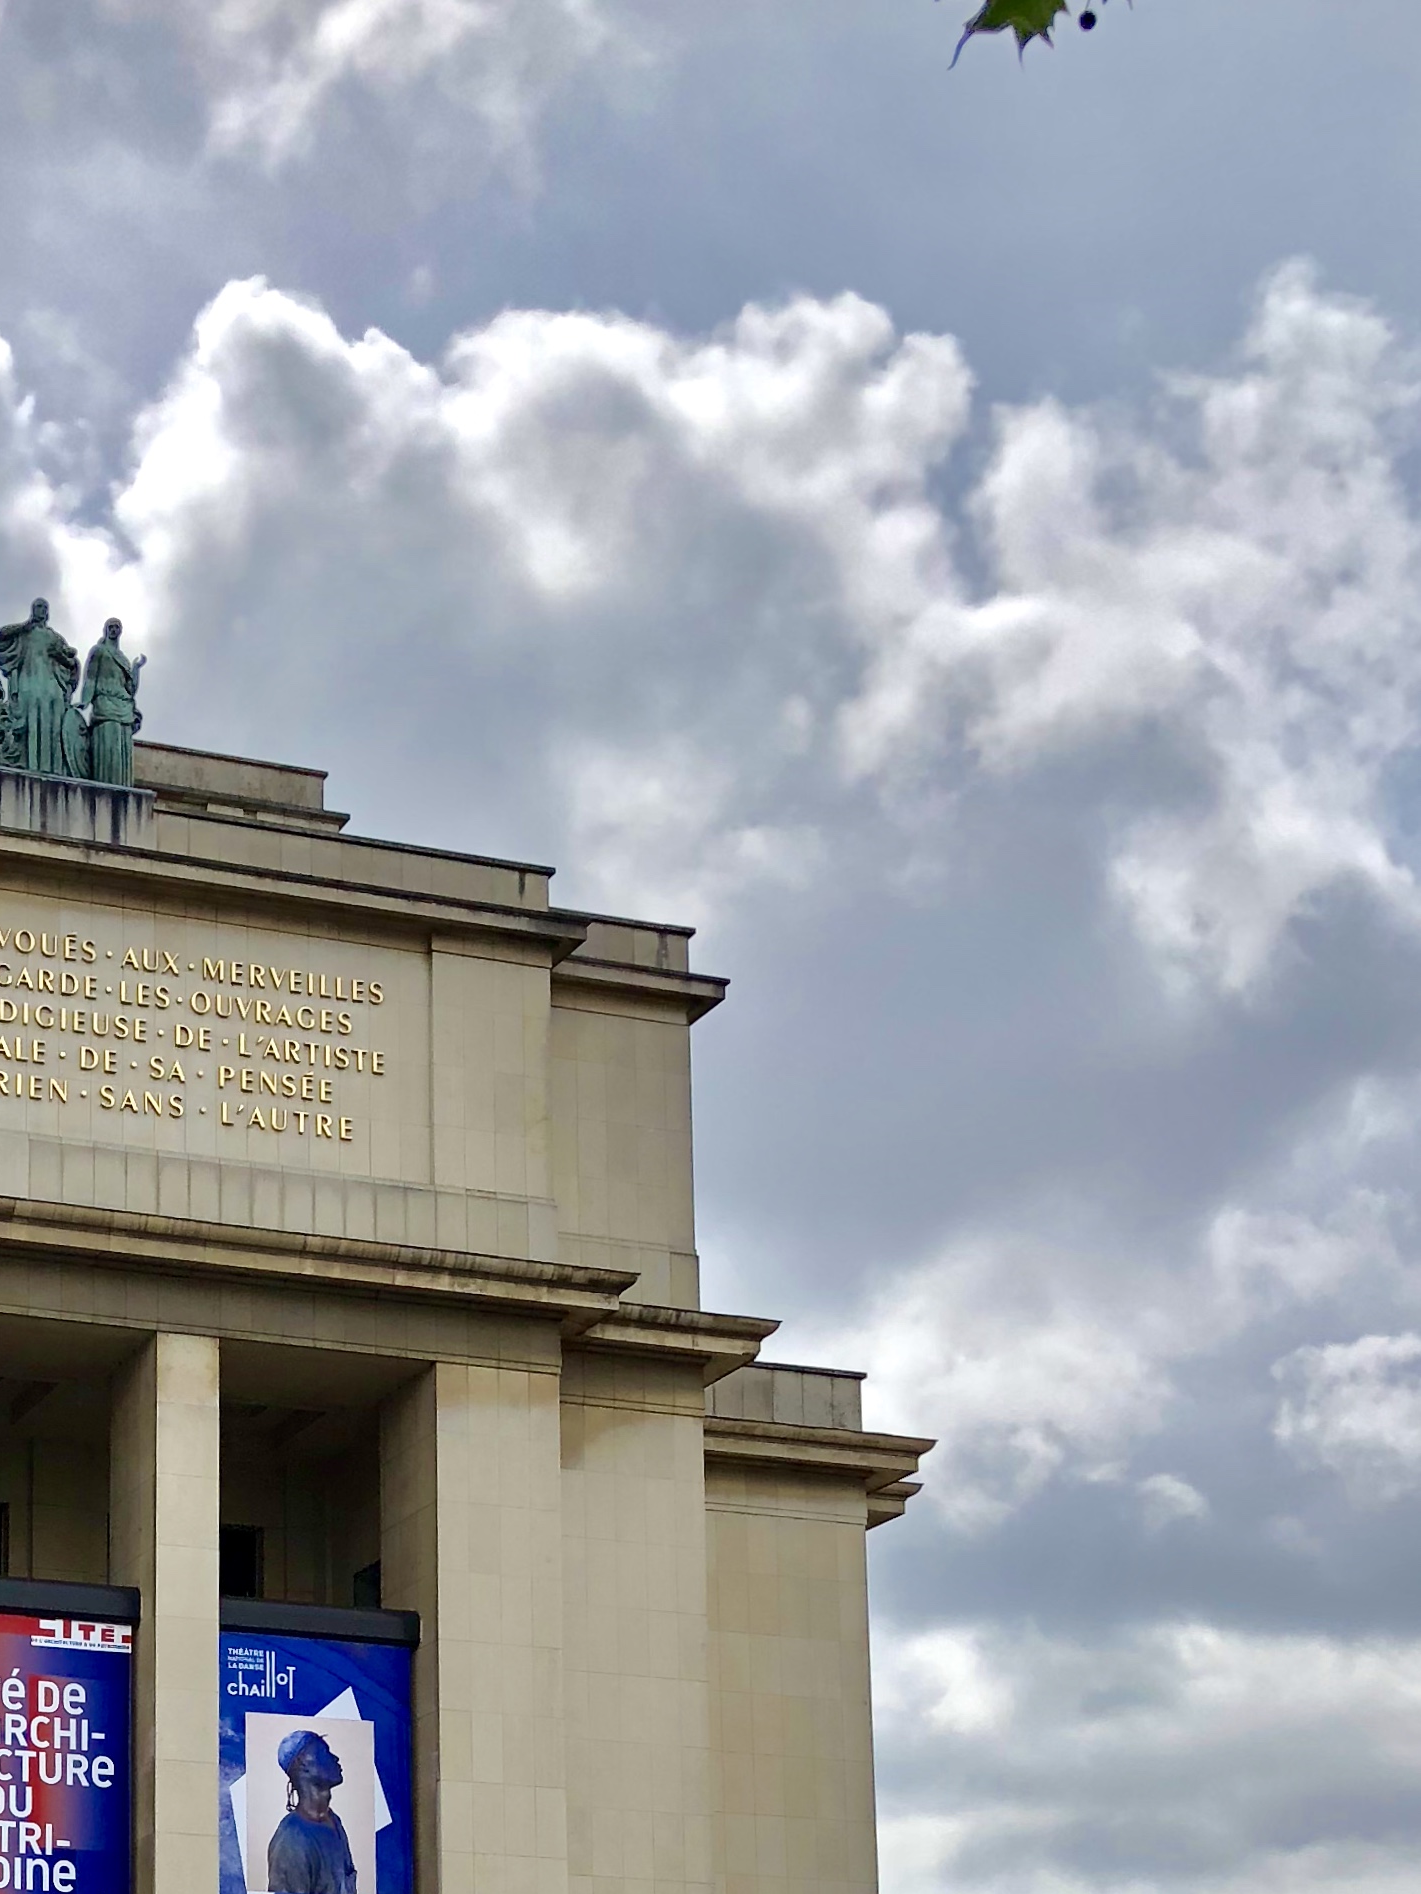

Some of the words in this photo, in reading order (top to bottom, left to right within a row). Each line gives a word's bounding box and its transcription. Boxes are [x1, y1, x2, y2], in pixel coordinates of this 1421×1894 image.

[122, 947, 180, 976] AUX
[202, 957, 385, 1005] MERVEILLES
[120, 980, 171, 1009] LES
[190, 991, 353, 1035] OUVRAGES
[80, 1045, 118, 1073] DE
[149, 1056, 186, 1083] SA
[218, 1065, 333, 1102] PENSÉE
[175, 1024, 212, 1051] DE
[238, 1032, 385, 1075] L'ARTISTE
[99, 1085, 185, 1118] SANS
[221, 1101, 354, 1141] L'AUTRE
